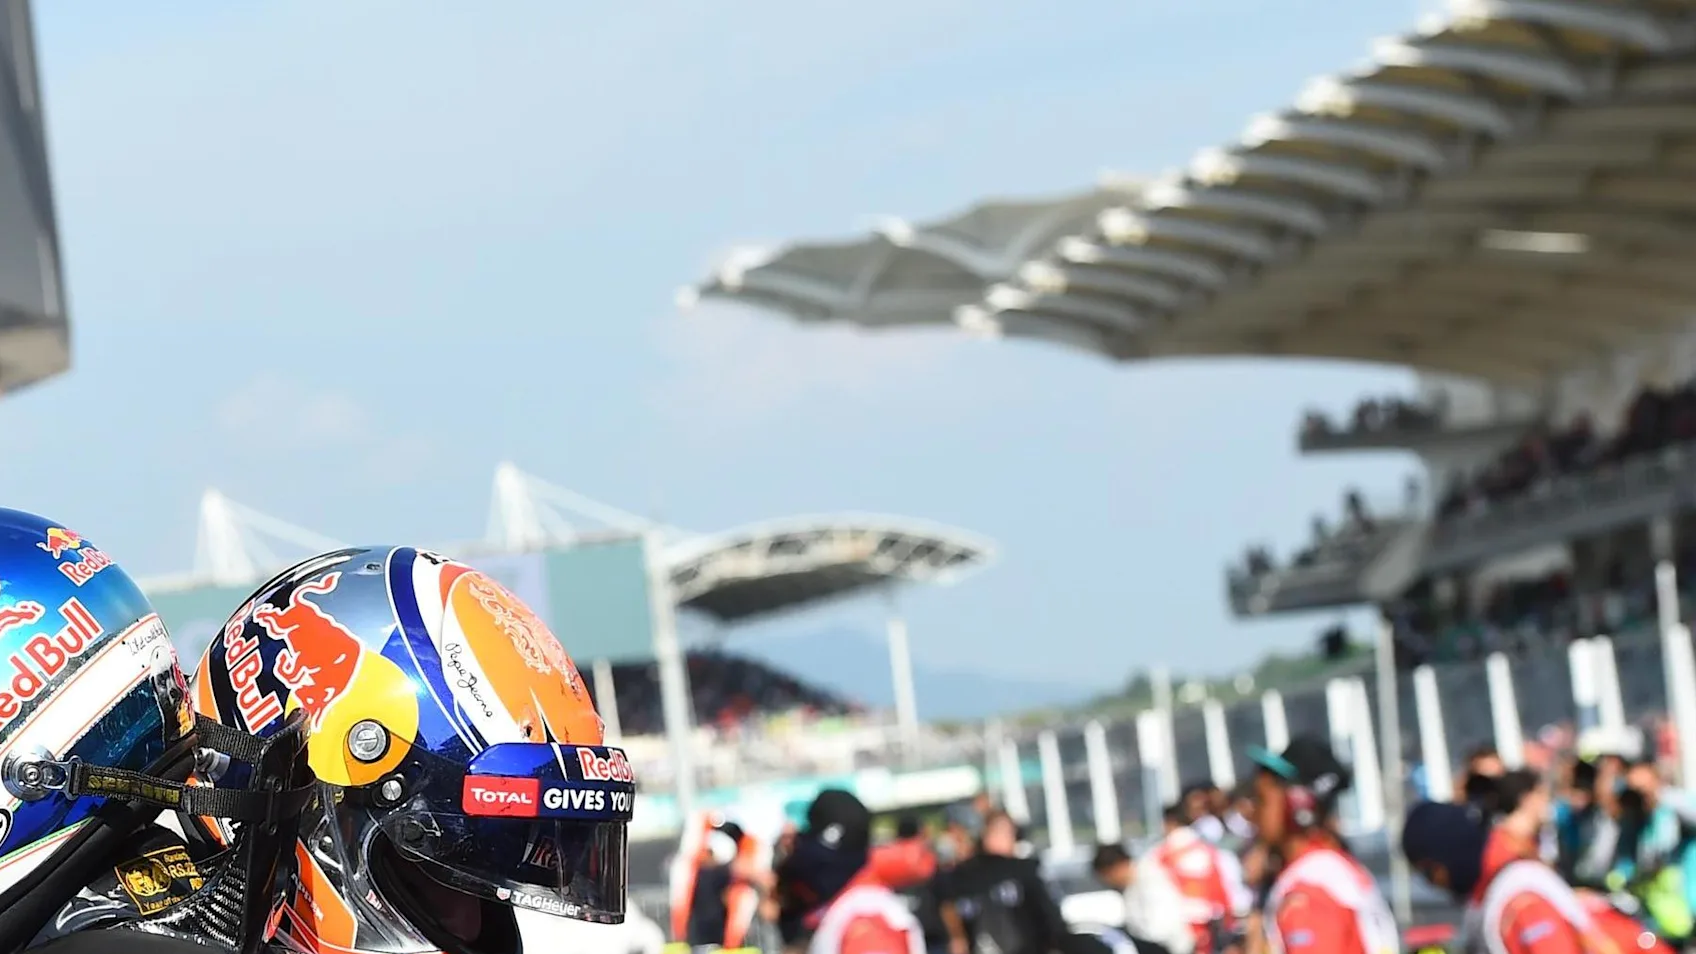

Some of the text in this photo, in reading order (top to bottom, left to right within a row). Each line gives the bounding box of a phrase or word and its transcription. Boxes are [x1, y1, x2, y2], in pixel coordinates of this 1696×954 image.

[444, 642, 466, 676] Pepe
[470, 787, 533, 805] TOTAL
[542, 787, 606, 812] GIVES
